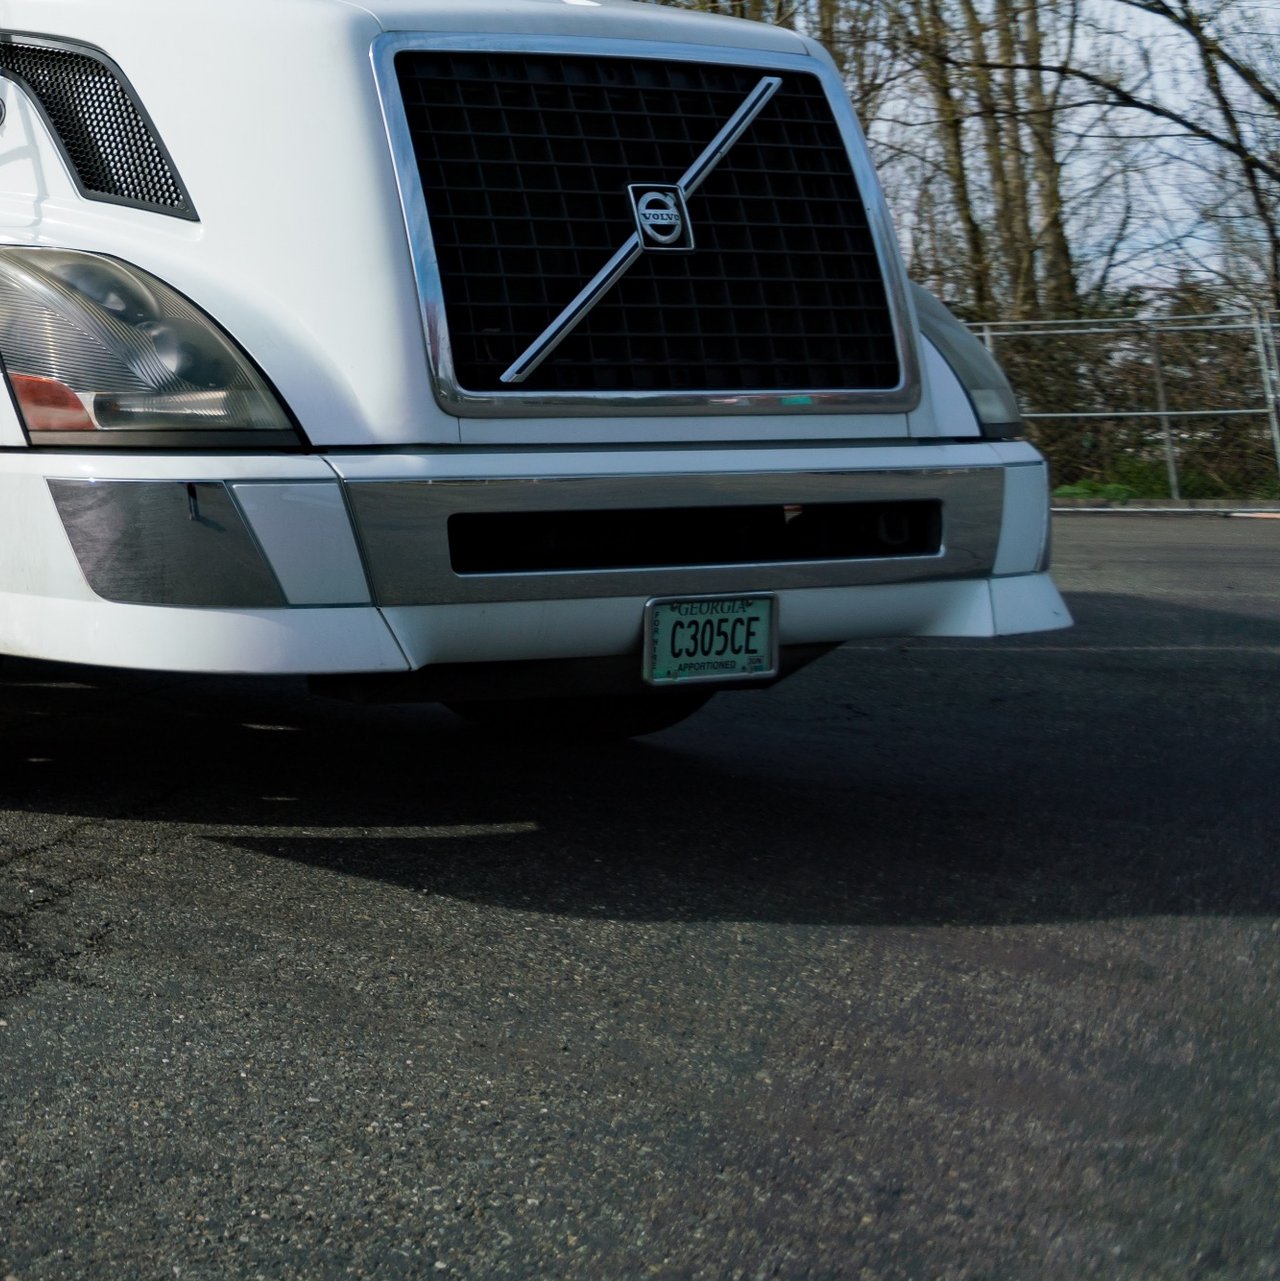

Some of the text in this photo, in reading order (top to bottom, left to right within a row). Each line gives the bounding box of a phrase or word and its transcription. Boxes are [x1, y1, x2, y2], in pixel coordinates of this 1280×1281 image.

[641, 213, 681, 221] VOLVO
[678, 599, 747, 616] GEORGIA
[671, 616, 760, 658] C305CE
[677, 660, 737, 672] APPORTIONED
